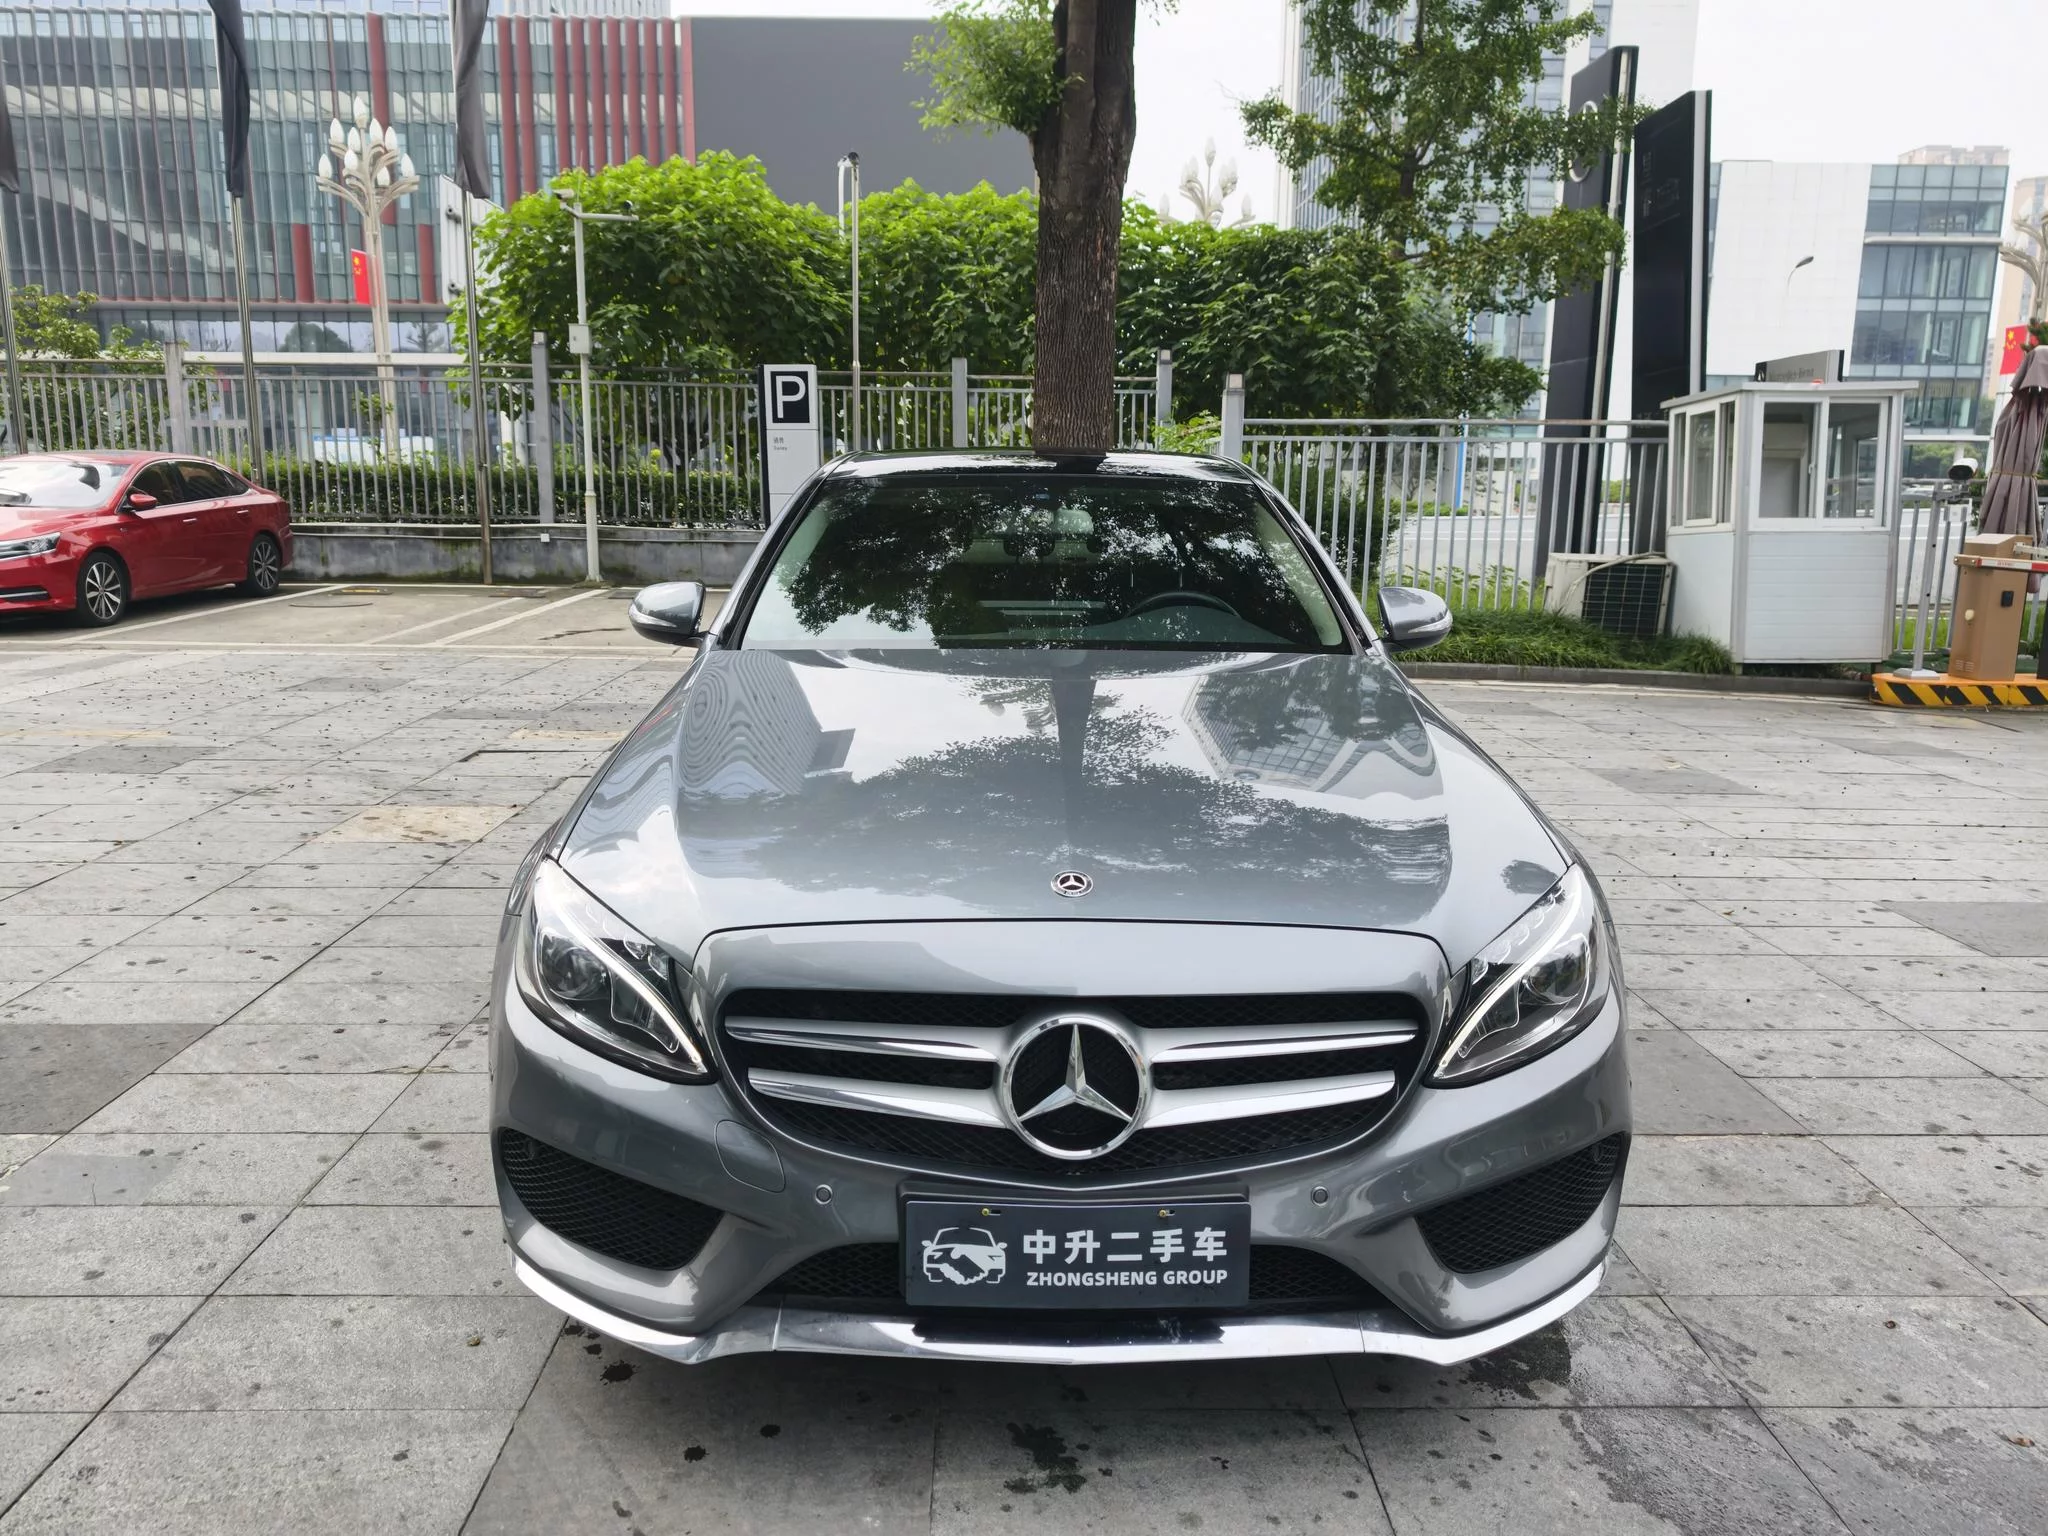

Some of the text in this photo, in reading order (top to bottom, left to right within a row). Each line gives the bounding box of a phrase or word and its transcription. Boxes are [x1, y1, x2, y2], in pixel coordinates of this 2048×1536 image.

[775, 375, 806, 419] P
[1022, 1226, 1229, 1265] 中升二手车
[1026, 1269, 1228, 1286] ZHONGSHENG GROUP
